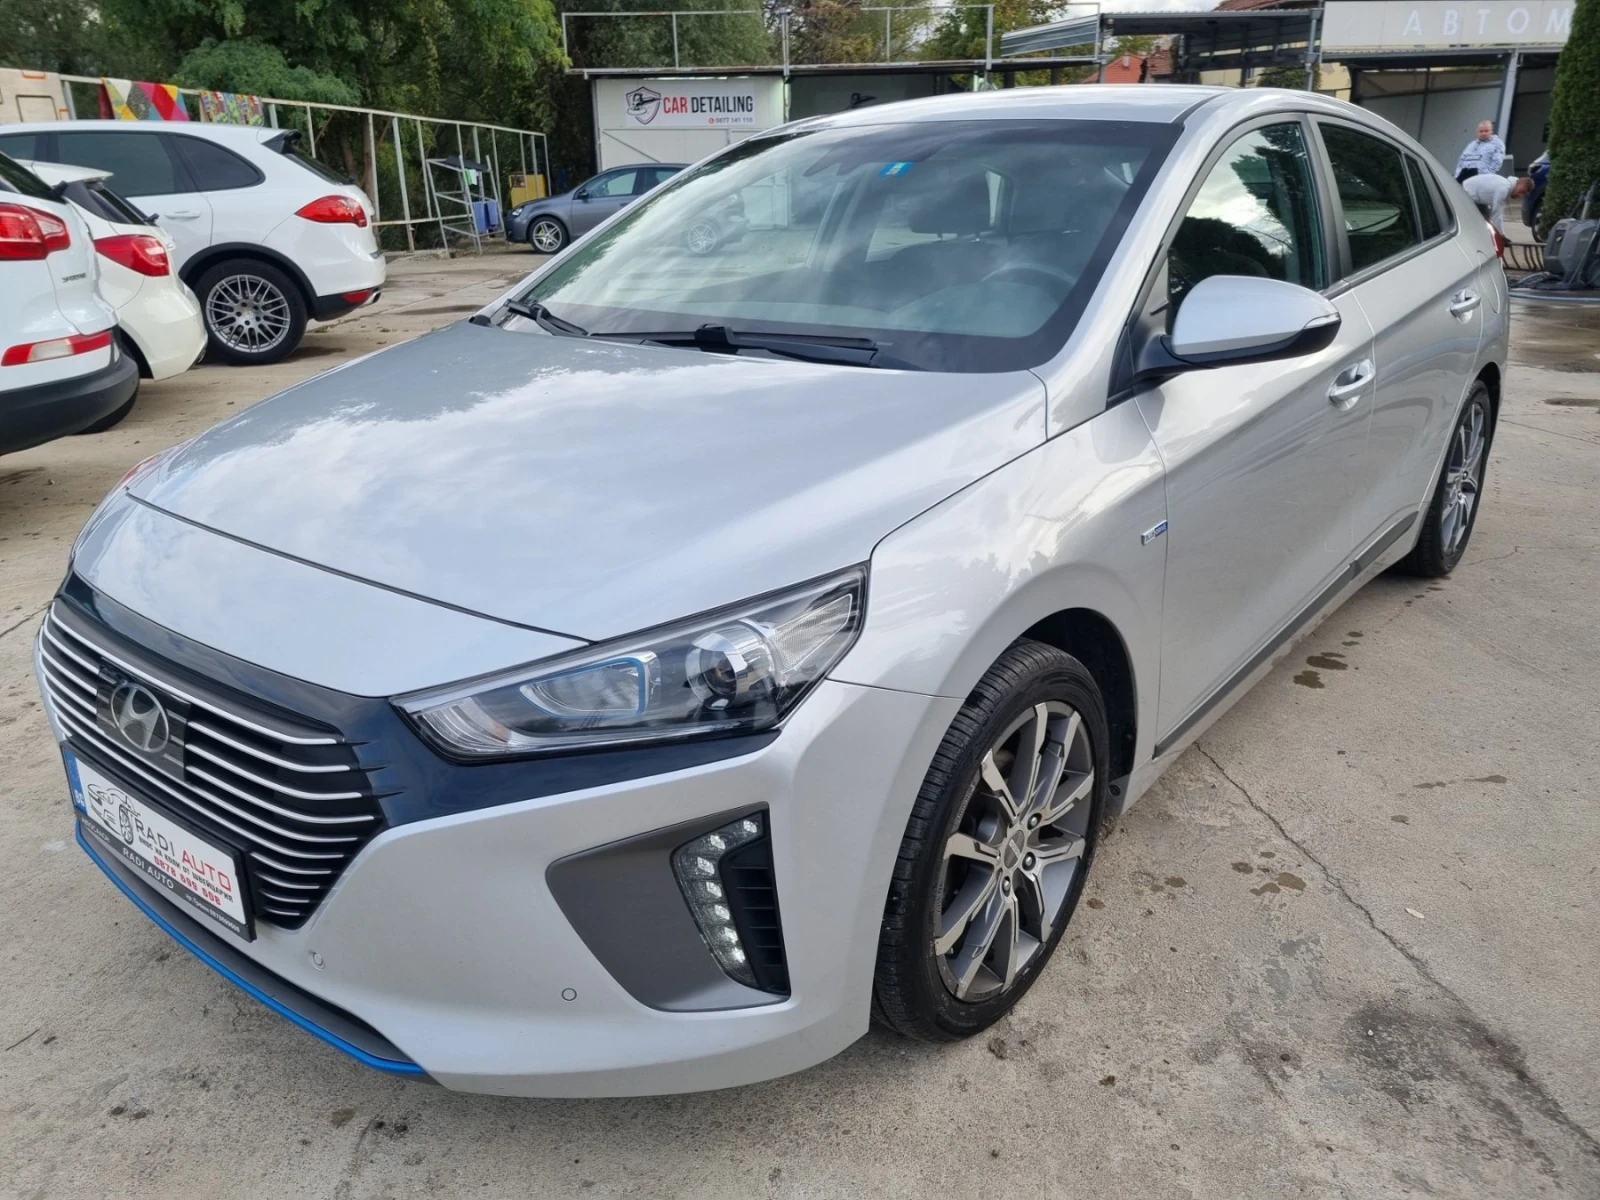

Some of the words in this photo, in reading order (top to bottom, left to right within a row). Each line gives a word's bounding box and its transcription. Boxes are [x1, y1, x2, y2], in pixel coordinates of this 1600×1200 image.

[663, 96, 688, 114] CAR
[691, 95, 753, 113] DETAILING
[122, 847, 145, 870] RADI
[147, 865, 175, 890] AUTO
[134, 818, 175, 857] RADI
[182, 849, 232, 893] AUTO
